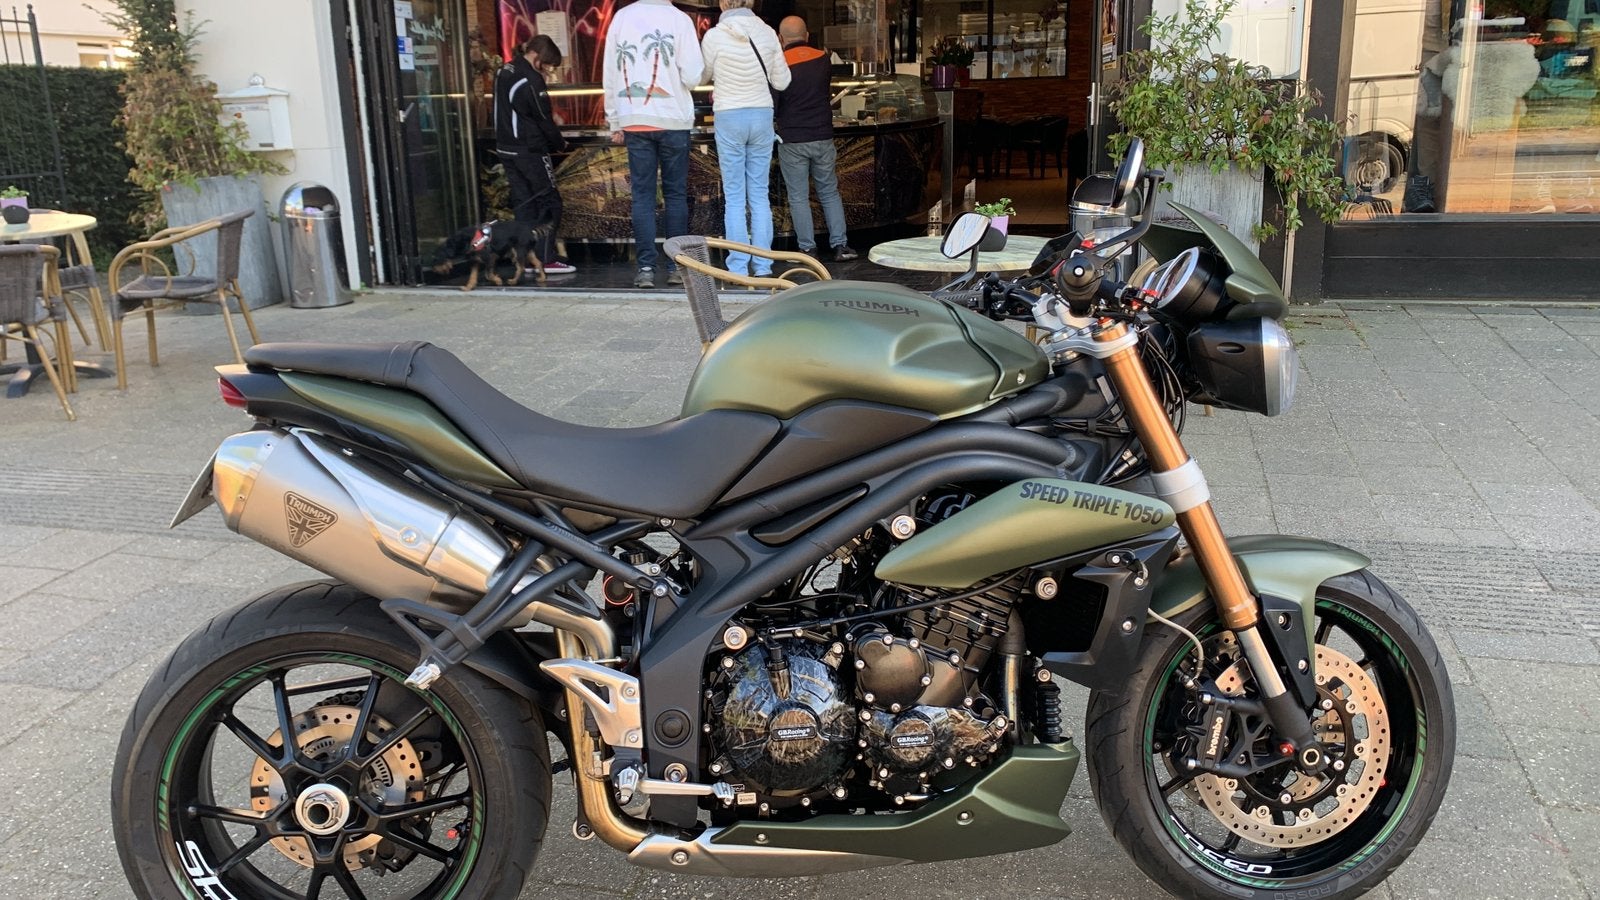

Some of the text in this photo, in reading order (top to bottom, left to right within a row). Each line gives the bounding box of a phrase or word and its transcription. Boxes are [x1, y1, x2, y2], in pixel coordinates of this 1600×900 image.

[818, 300, 920, 318] TRIUMPH
[289, 495, 331, 523] TRIUMPH
[1019, 481, 1164, 526] SPEED TRIPLE 1050
[1336, 604, 1380, 636] TRIUMPH
[1206, 716, 1224, 756] brembo
[1274, 885, 1331, 900] ROSSO
